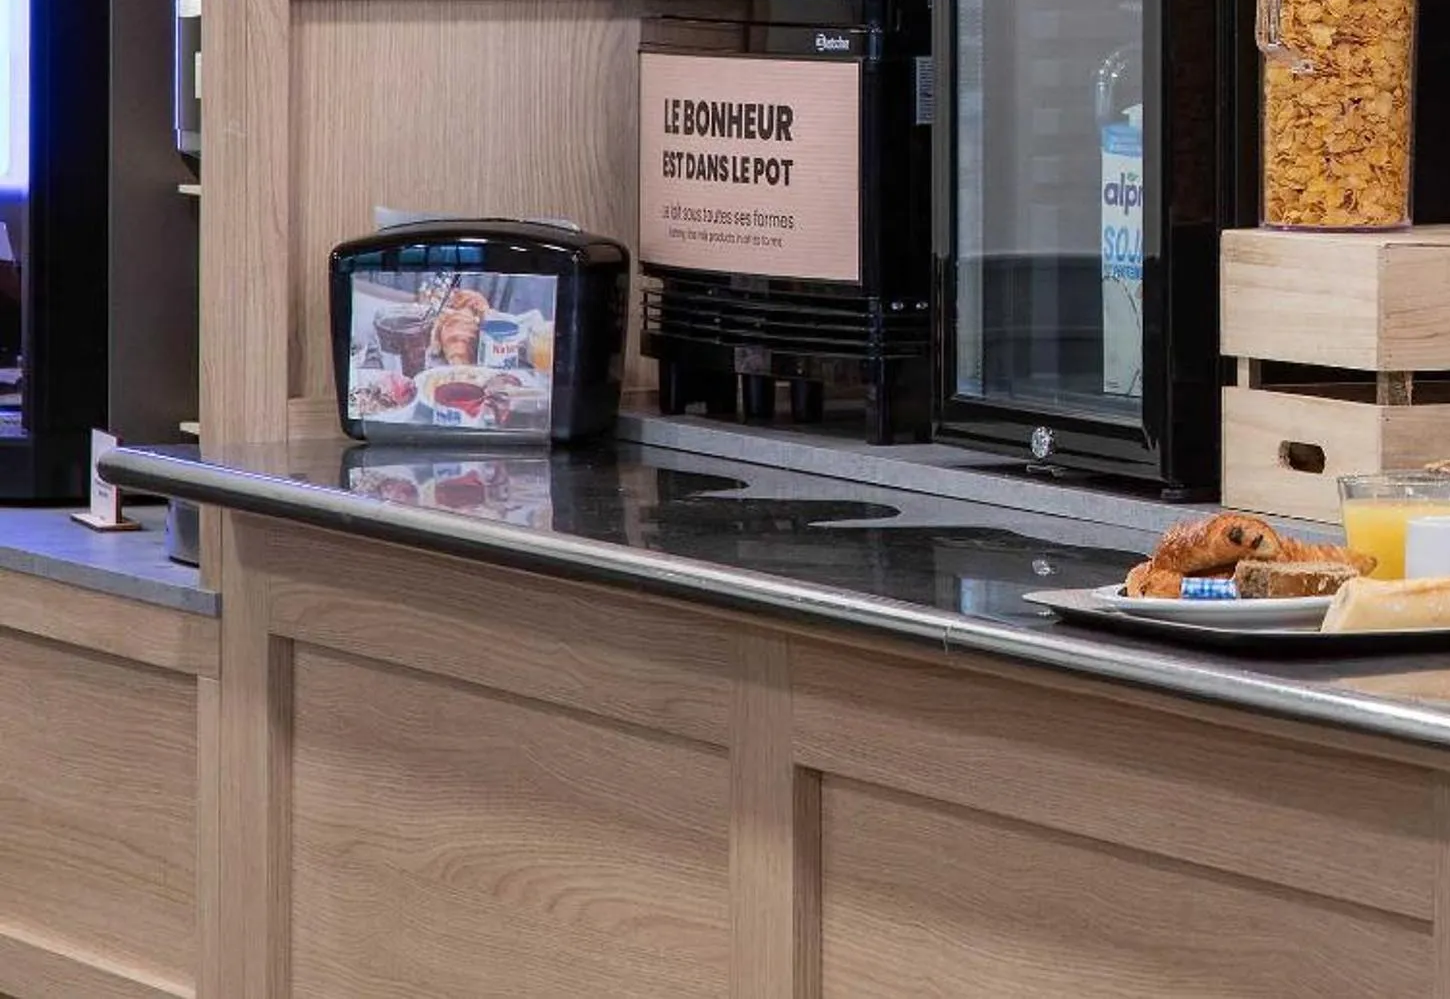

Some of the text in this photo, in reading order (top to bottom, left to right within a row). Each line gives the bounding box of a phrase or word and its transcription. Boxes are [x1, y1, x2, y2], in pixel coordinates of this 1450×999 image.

[664, 99, 794, 142] LE BONHEUR
[662, 150, 794, 187] EST DANS LE POT
[734, 210, 752, 227] ses
[753, 209, 795, 229] formes
